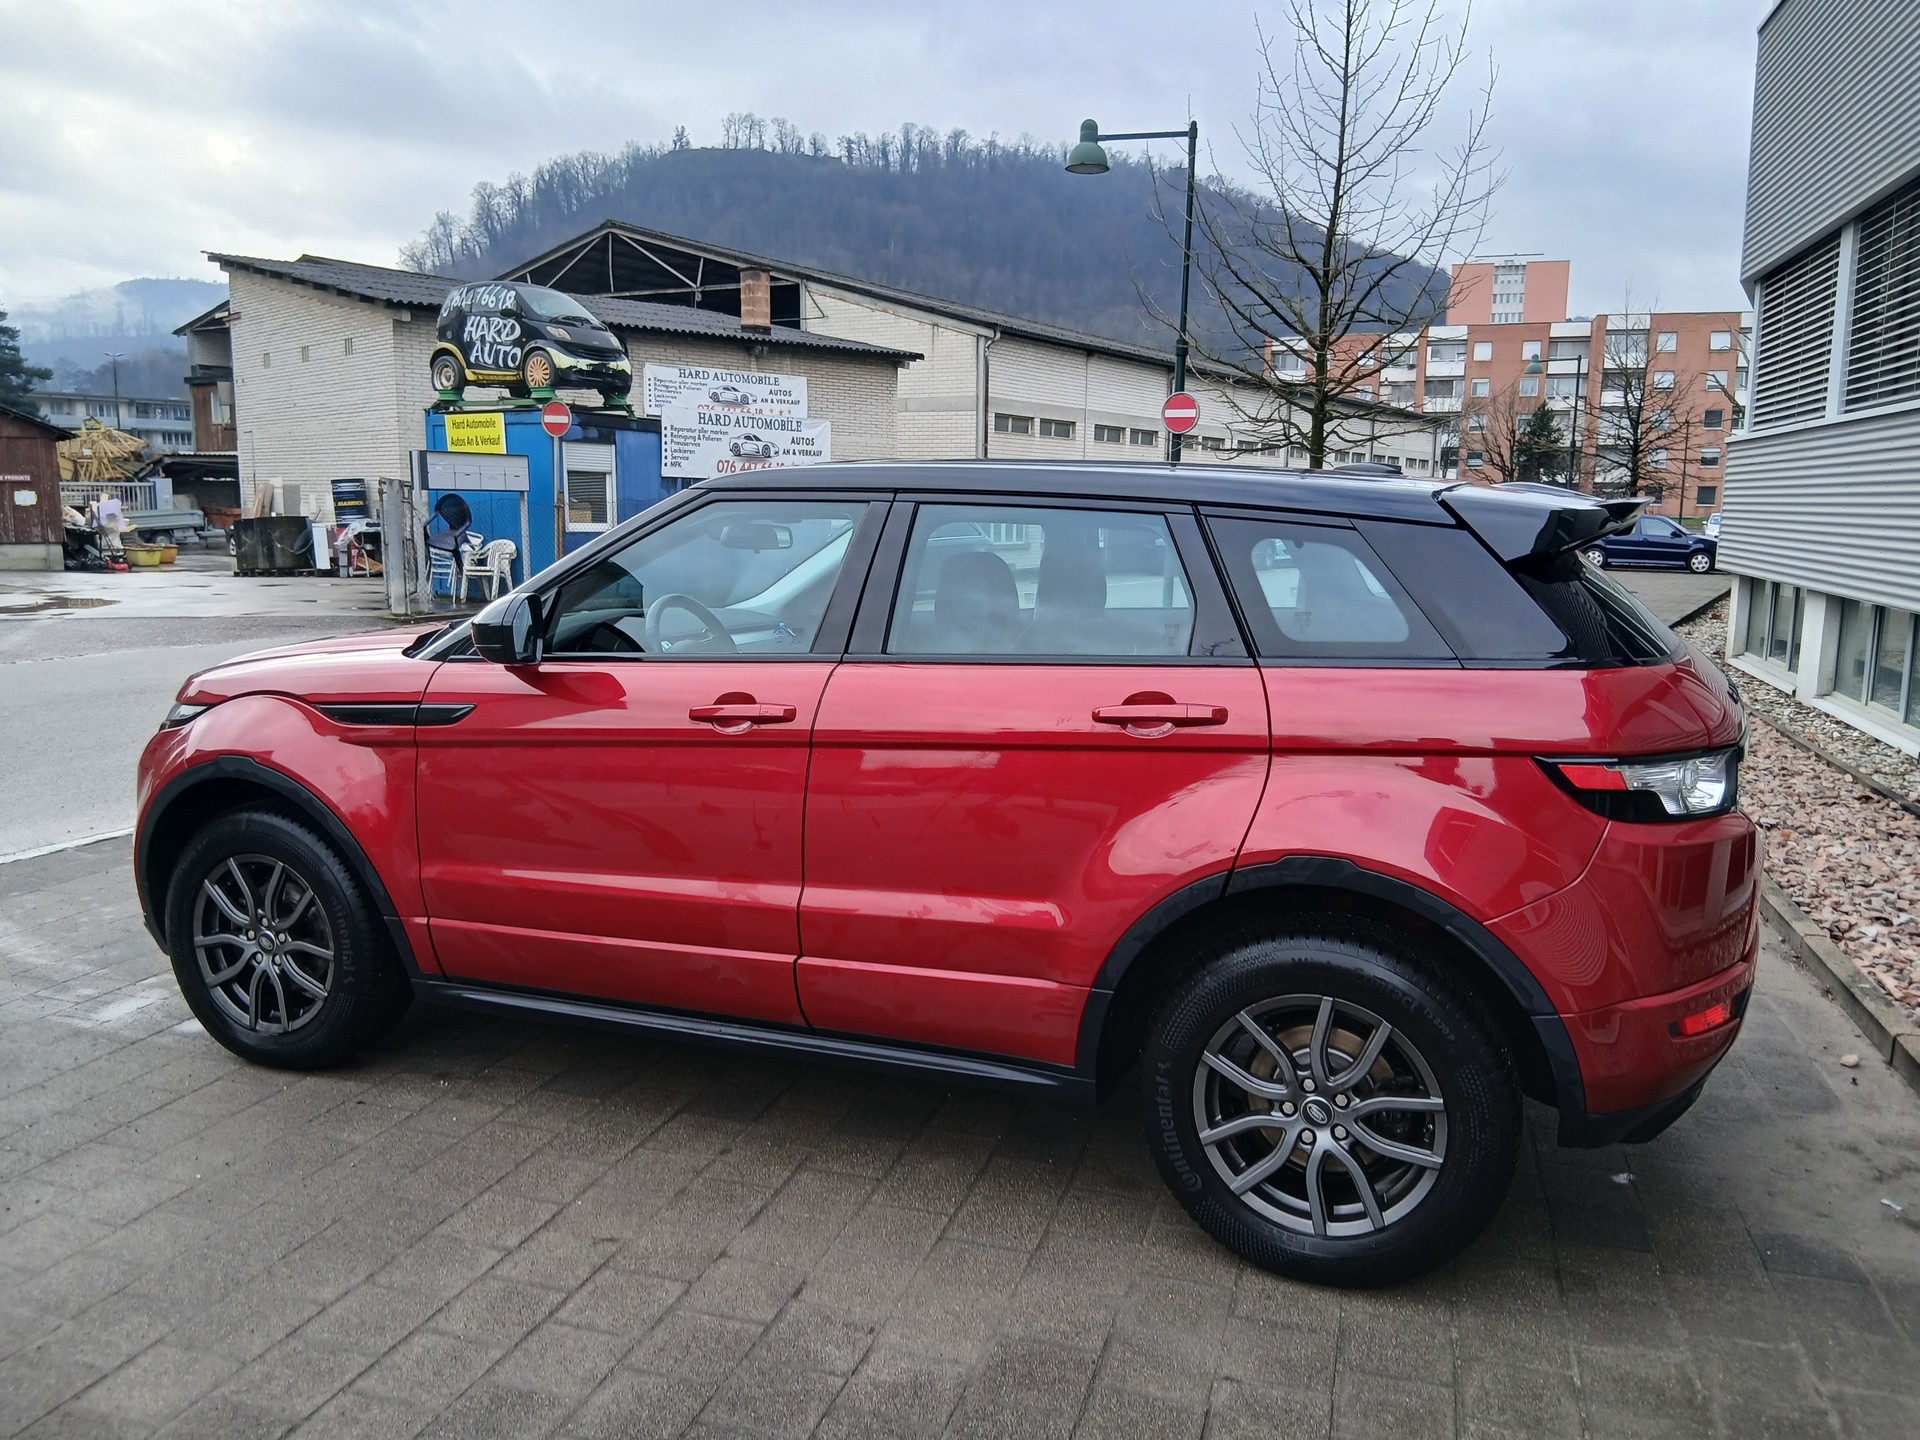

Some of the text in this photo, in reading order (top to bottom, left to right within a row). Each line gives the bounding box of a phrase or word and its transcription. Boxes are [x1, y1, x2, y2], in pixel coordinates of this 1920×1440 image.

[464, 315, 521, 342] HARD
[470, 341, 522, 368] AUTO
[678, 369, 709, 380] HARD
[769, 389, 792, 397] AUTOS
[451, 418, 496, 430] Hard Automobile
[698, 412, 731, 427] HARD
[670, 425, 697, 434] Reparatur
[451, 435, 501, 447] Autos An & Verkauf
[670, 432, 696, 442] Reinigung
[702, 434, 722, 442] Polieren
[790, 436, 815, 446] AUTOS
[670, 439, 701, 447] Pneuservice
[782, 448, 790, 456] AN
[798, 449, 822, 457] VERKAUF
[717, 460, 736, 473] 076
[1156, 1076, 1202, 1192] Continental
